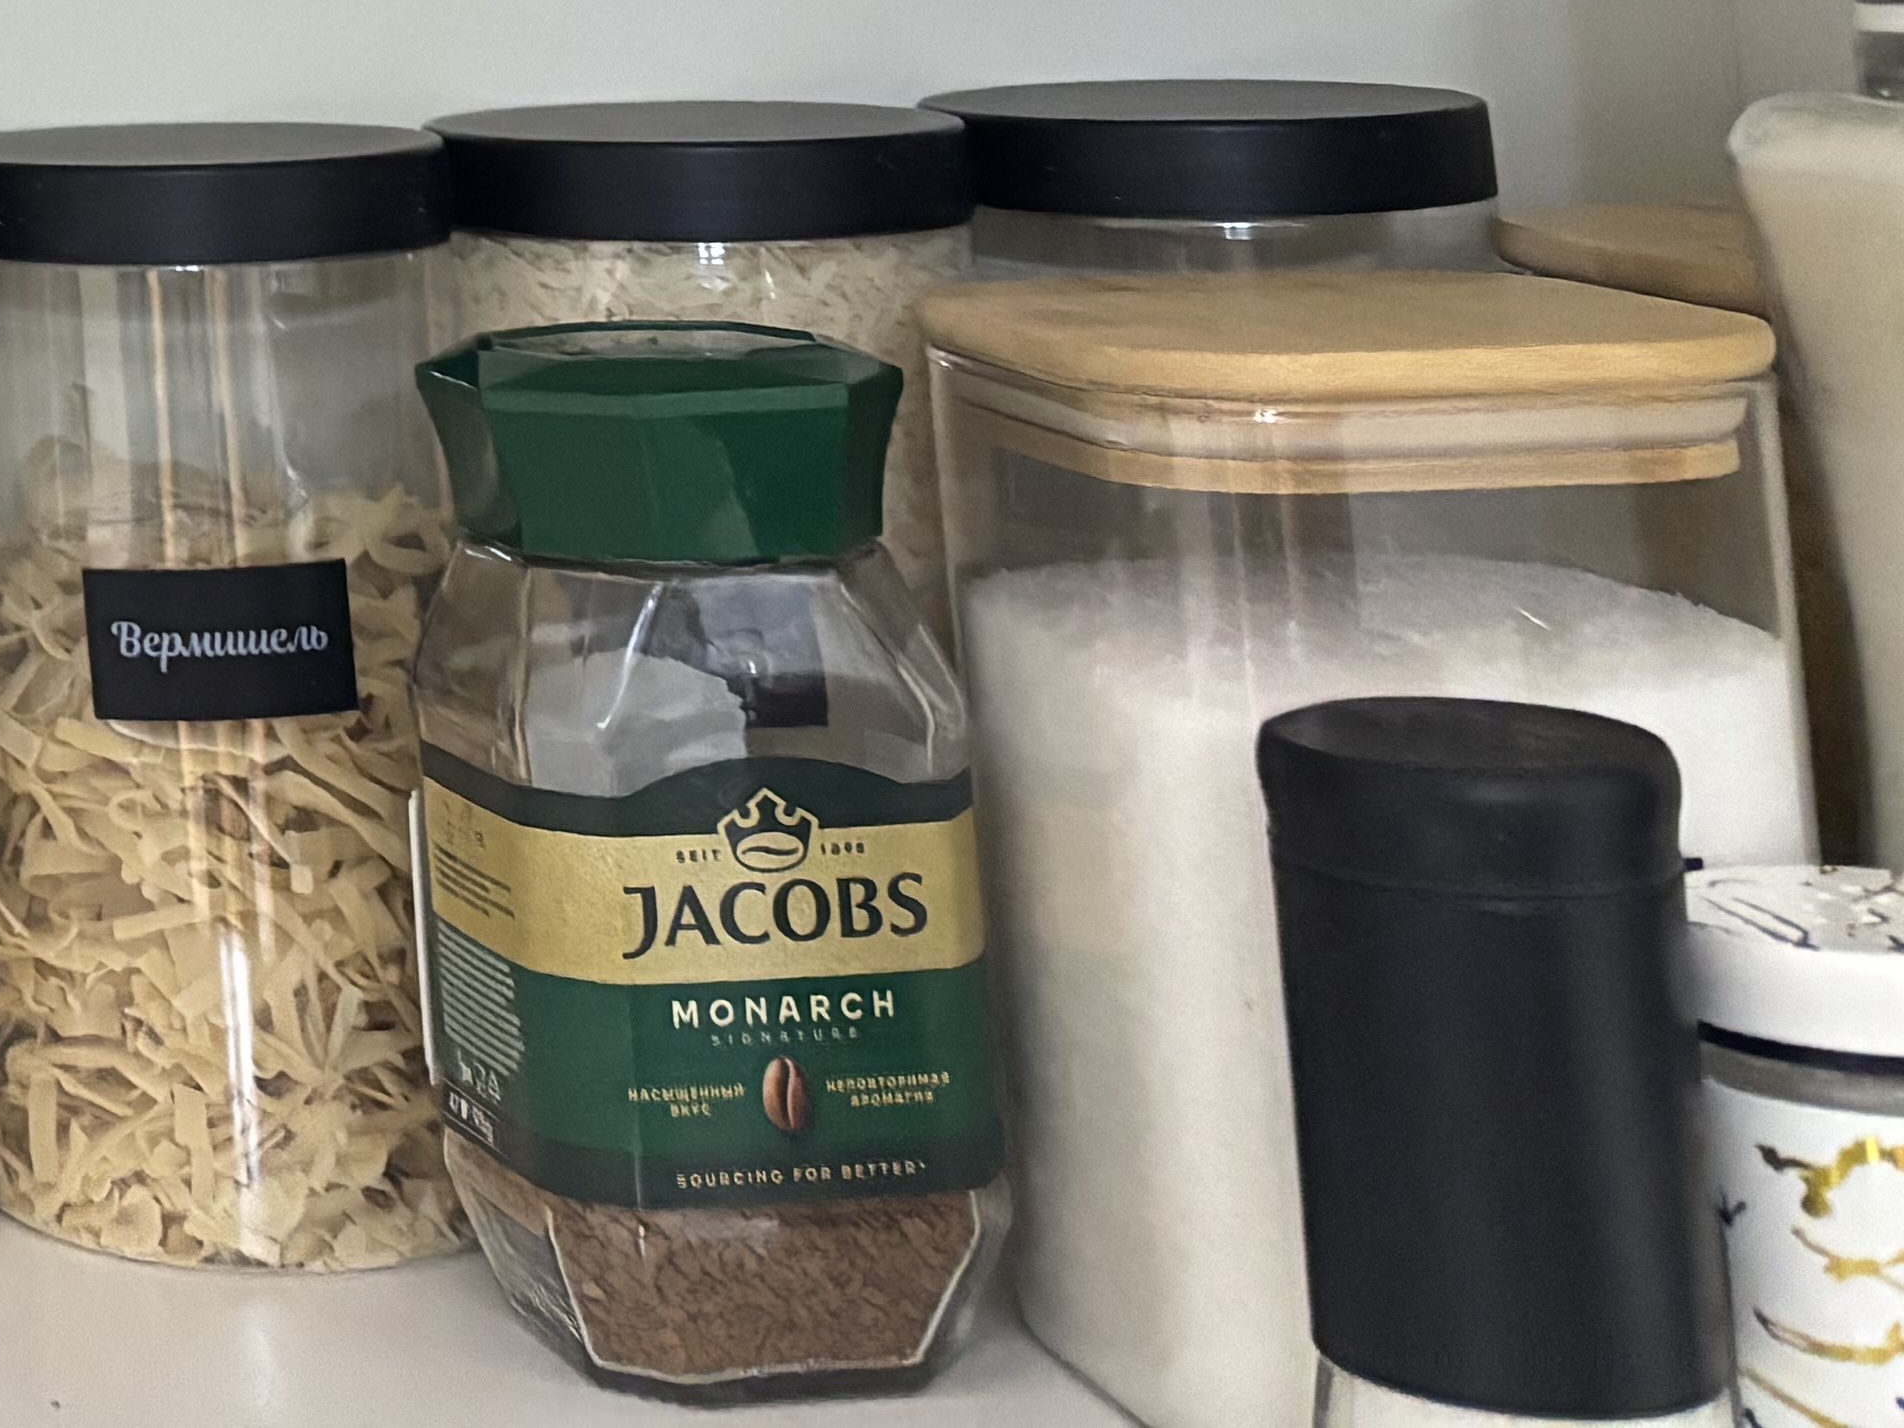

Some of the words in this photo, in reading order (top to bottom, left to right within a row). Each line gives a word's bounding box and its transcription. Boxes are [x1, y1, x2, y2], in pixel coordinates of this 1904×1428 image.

[110, 620, 329, 673] Вермишель
[622, 872, 928, 960] JACOBS
[671, 990, 894, 1030] MONARCH
[628, 1083, 745, 1102] НАСЫЩЕННЫЙ
[676, 1169, 784, 1190] SOURCING
[793, 1166, 832, 1183] FOR
[842, 1160, 917, 1180] BETTER
